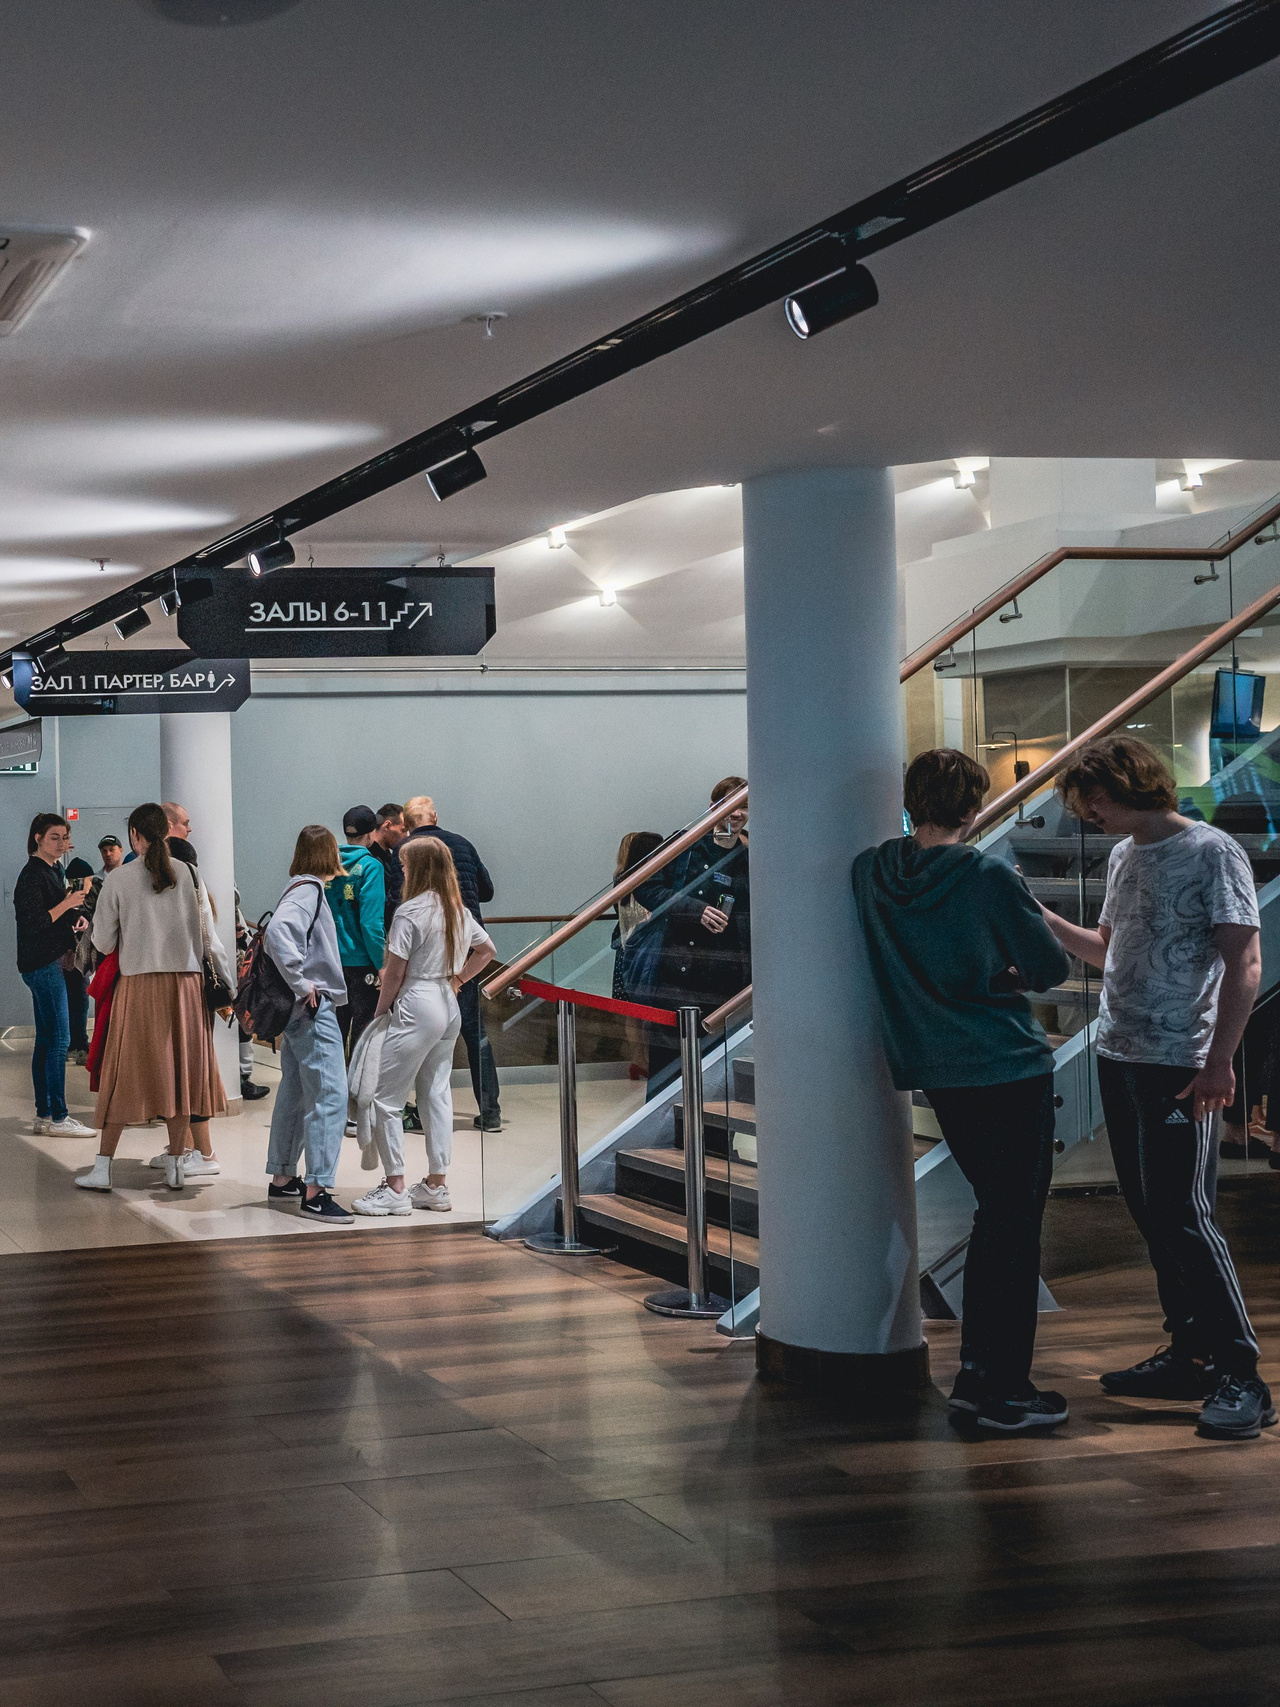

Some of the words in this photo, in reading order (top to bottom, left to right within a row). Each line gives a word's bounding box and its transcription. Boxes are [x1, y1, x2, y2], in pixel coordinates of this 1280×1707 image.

[249, 601, 327, 622] ЗАЛЫ
[333, 601, 387, 622] 6-11
[30, 675, 72, 691] ЗАЛ
[79, 675, 87, 690] 1
[94, 673, 165, 691] ПАРТЕР,
[170, 673, 206, 688] БАР
